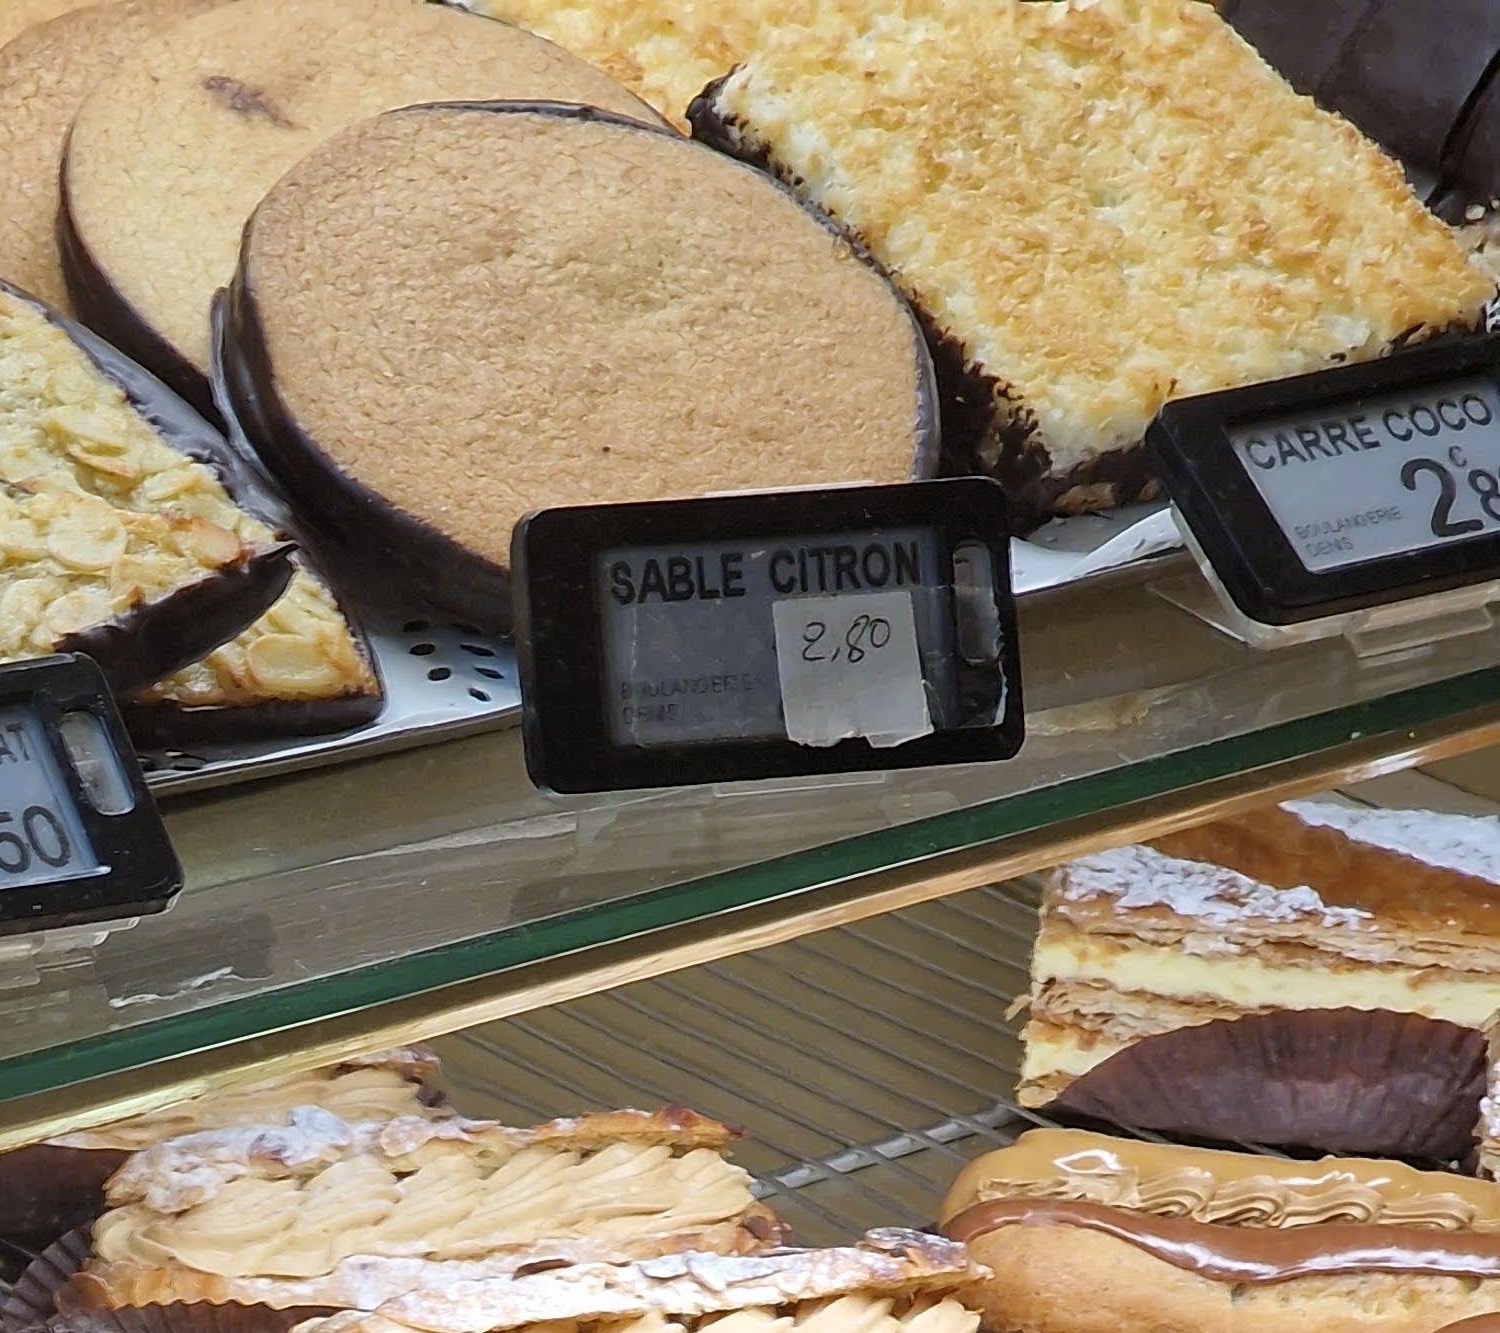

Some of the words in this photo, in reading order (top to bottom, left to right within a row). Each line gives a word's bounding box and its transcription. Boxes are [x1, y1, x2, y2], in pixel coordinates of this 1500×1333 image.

[1245, 415, 1382, 471] CARRE
[1382, 392, 1493, 442] COCO
[609, 551, 747, 604] SABLE
[768, 540, 923, 596] CITRON
[801, 613, 891, 664] 2,80
